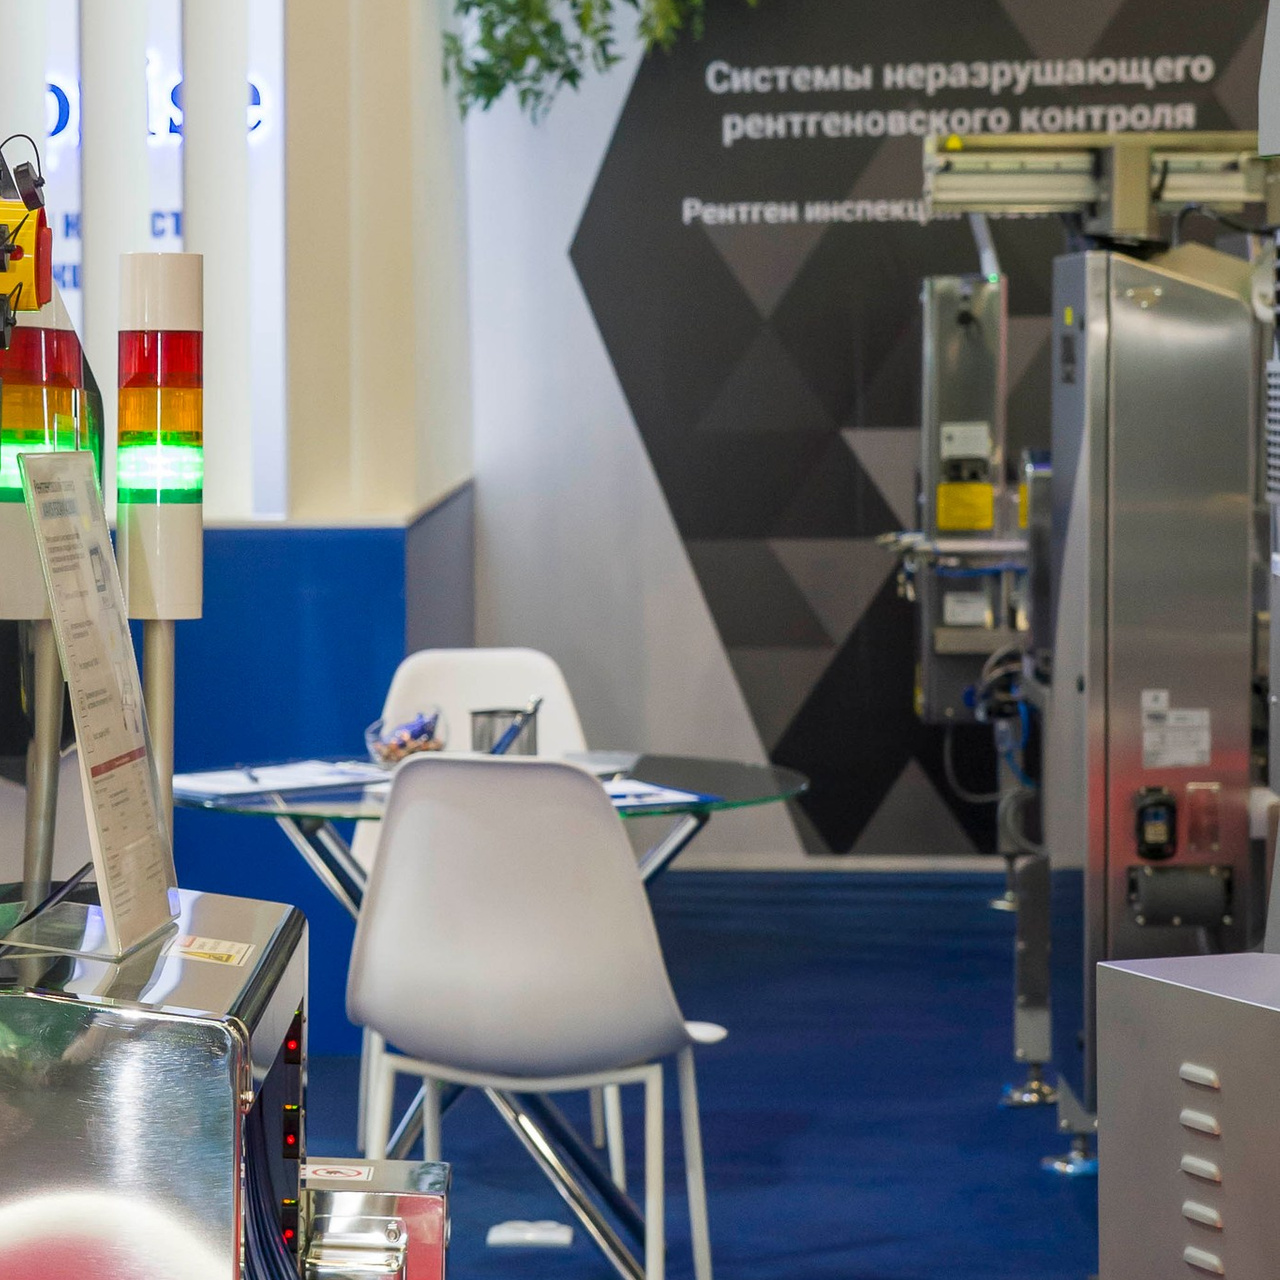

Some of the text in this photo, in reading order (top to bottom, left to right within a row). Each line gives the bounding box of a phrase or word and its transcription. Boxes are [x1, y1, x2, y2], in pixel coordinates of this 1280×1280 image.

[704, 54, 1216, 96] Системы неразрушающего
[721, 101, 1196, 147] рентгеновского контроля
[681, 196, 799, 226] Рентген
